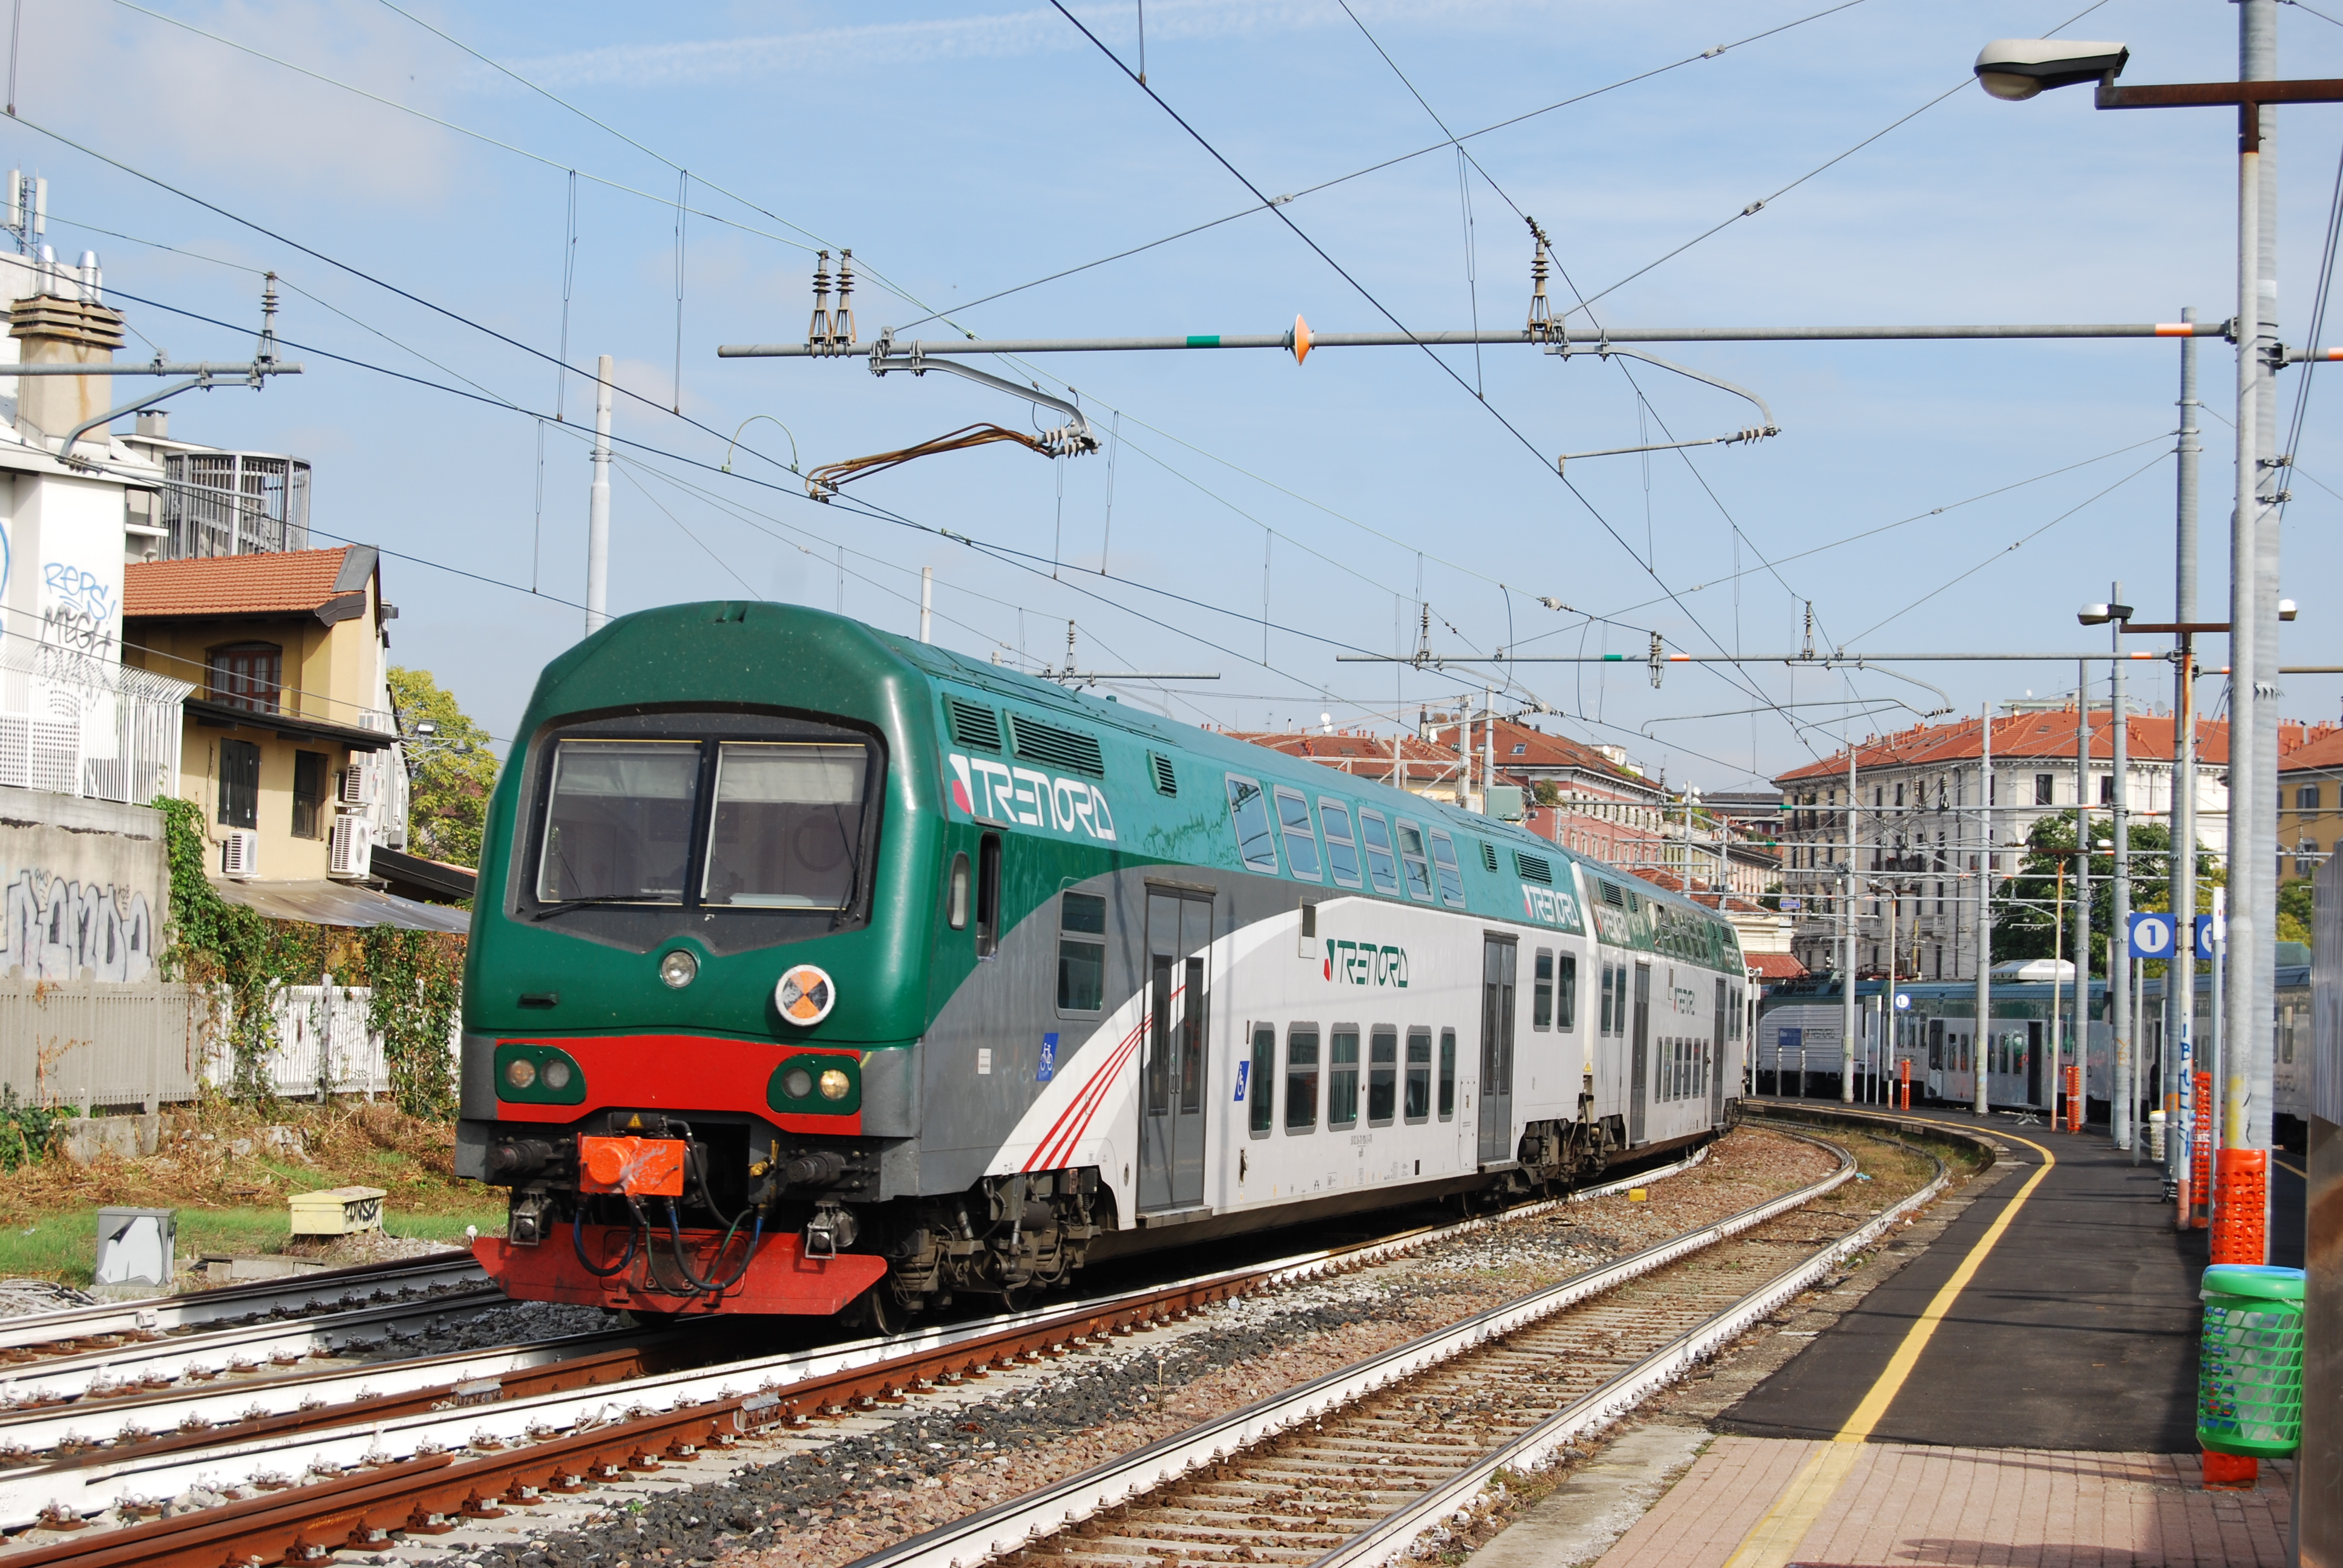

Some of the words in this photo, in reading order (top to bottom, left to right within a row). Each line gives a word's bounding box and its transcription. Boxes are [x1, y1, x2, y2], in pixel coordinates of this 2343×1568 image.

[971, 757, 1116, 841] TRENORD
[1529, 885, 1580, 927] TRENORD
[2147, 925, 2155, 946] 1
[1337, 939, 1408, 988] TRENORD
